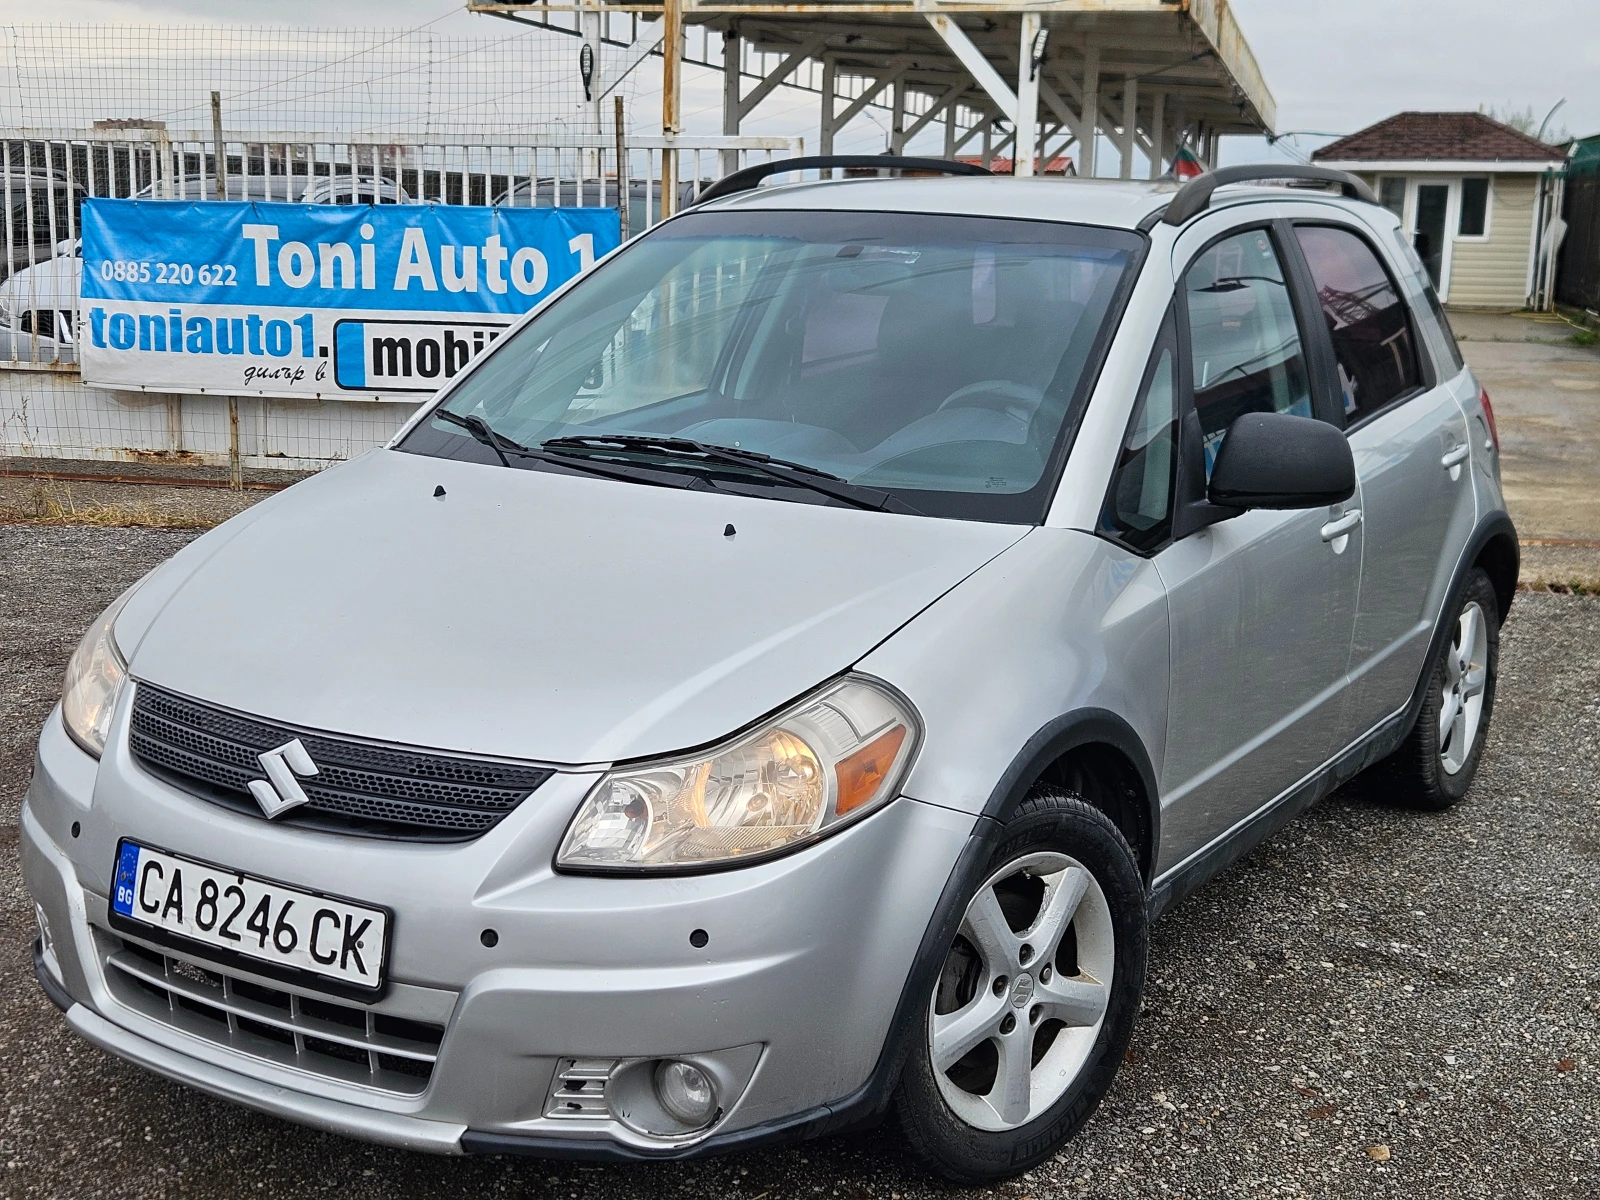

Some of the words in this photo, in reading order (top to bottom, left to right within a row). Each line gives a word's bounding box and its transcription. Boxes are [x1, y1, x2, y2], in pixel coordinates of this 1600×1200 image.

[101, 260, 150, 283] 0885
[155, 262, 194, 285] 220
[198, 264, 237, 286] 622
[242, 223, 376, 289] Toni
[393, 227, 548, 296] Auto
[88, 307, 329, 358] toniauto1.
[372, 330, 500, 378] mob
[244, 364, 306, 386] дилър
[117, 885, 132, 906] BG
[139, 860, 183, 924] CA
[195, 878, 298, 954] 8246
[310, 908, 373, 976] CK
